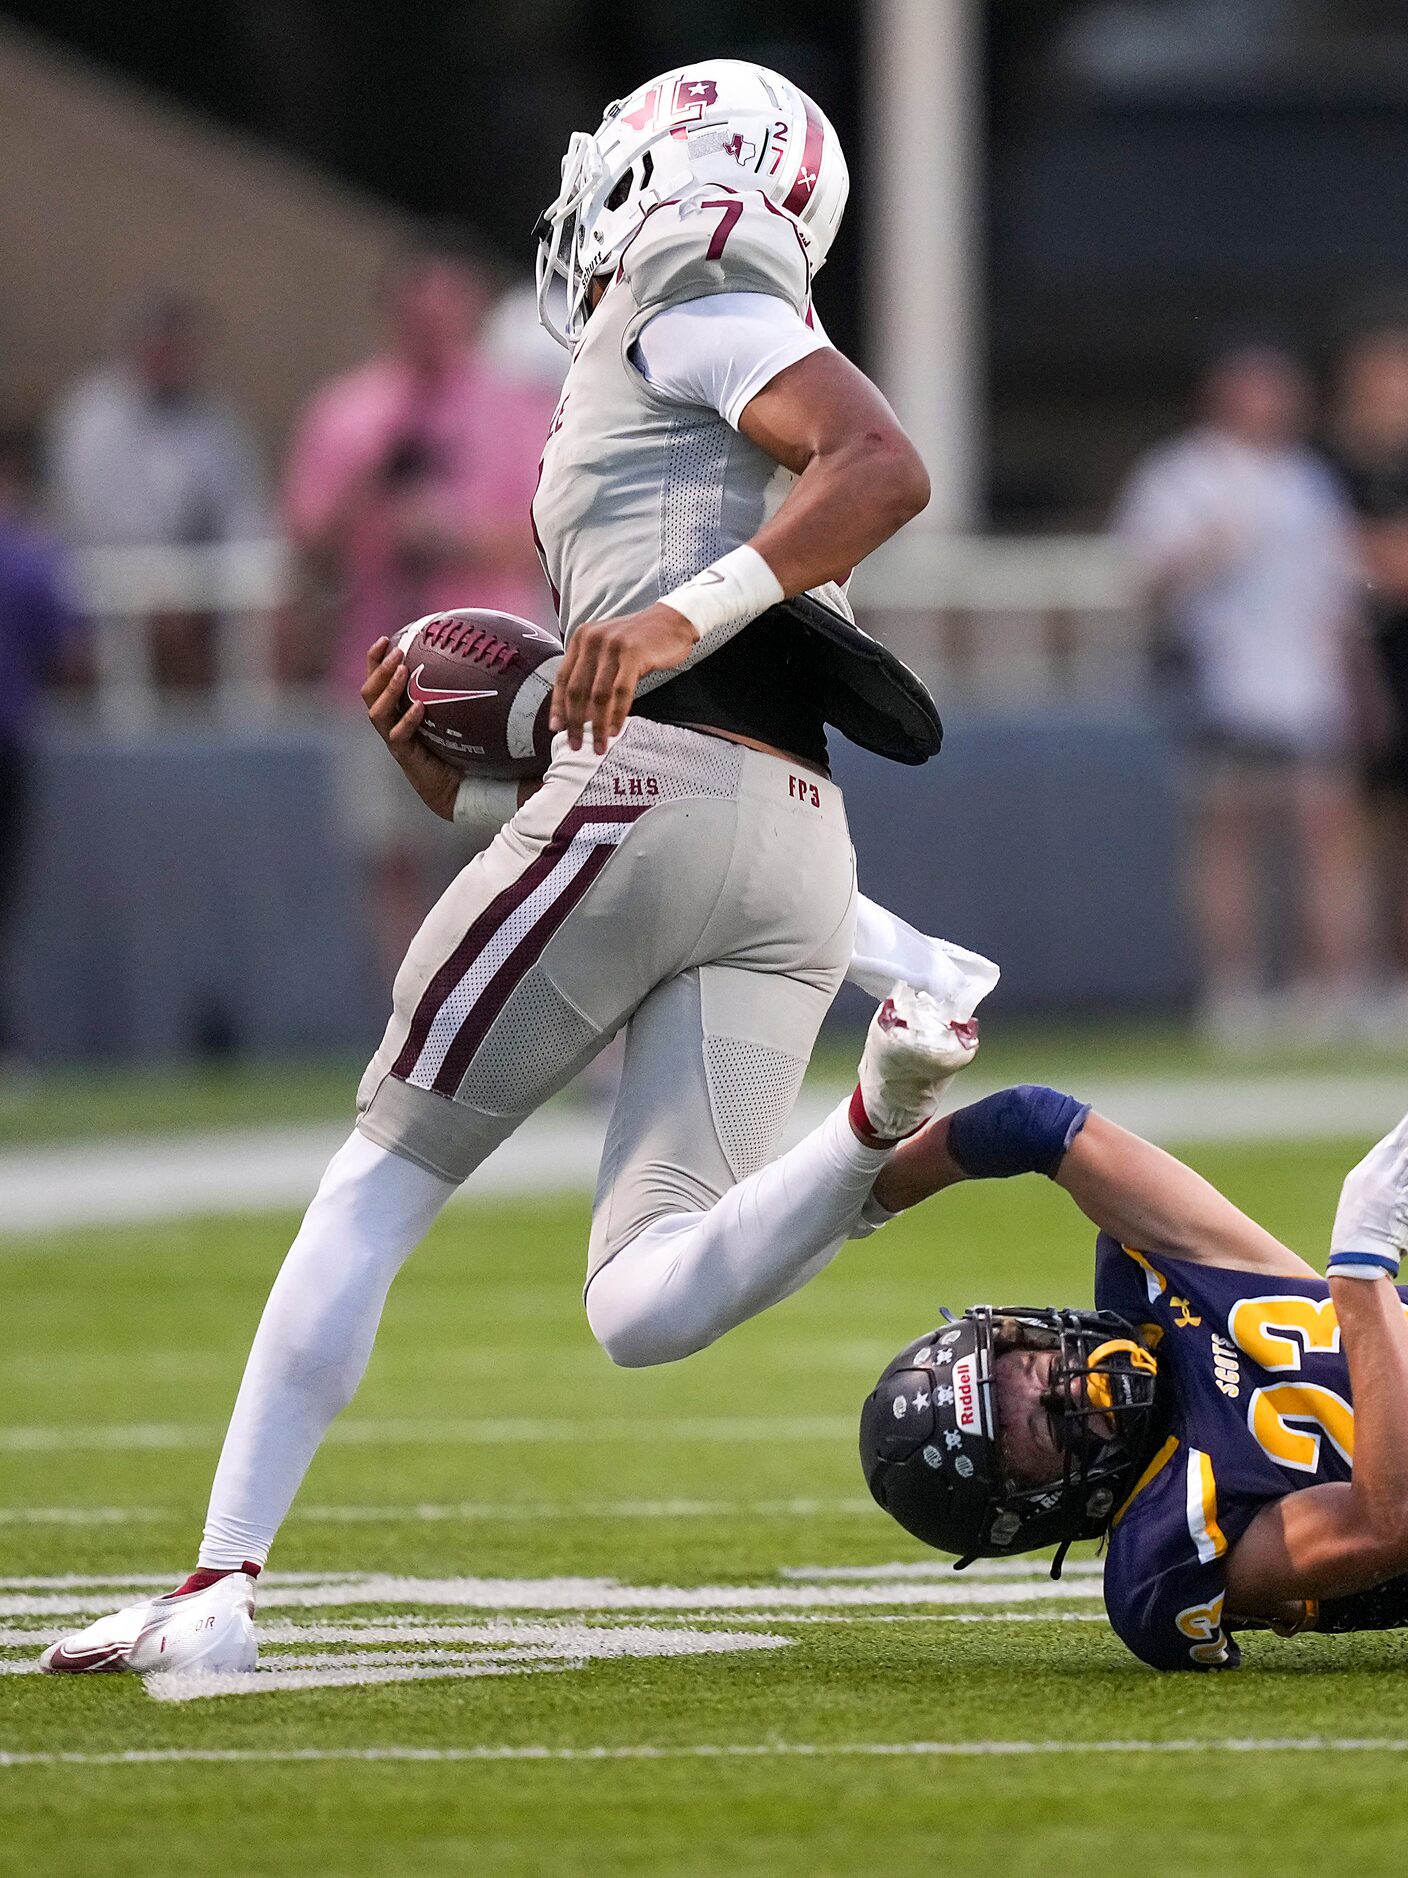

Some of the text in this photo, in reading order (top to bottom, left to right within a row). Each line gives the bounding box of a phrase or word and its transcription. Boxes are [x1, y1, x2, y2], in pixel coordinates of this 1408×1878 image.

[700, 200, 743, 261] 7
[612, 776, 660, 796] LHS
[787, 774, 821, 809] FP3
[956, 1363, 974, 1426] Riddell
[1210, 1332, 1241, 1399] SCOTS
